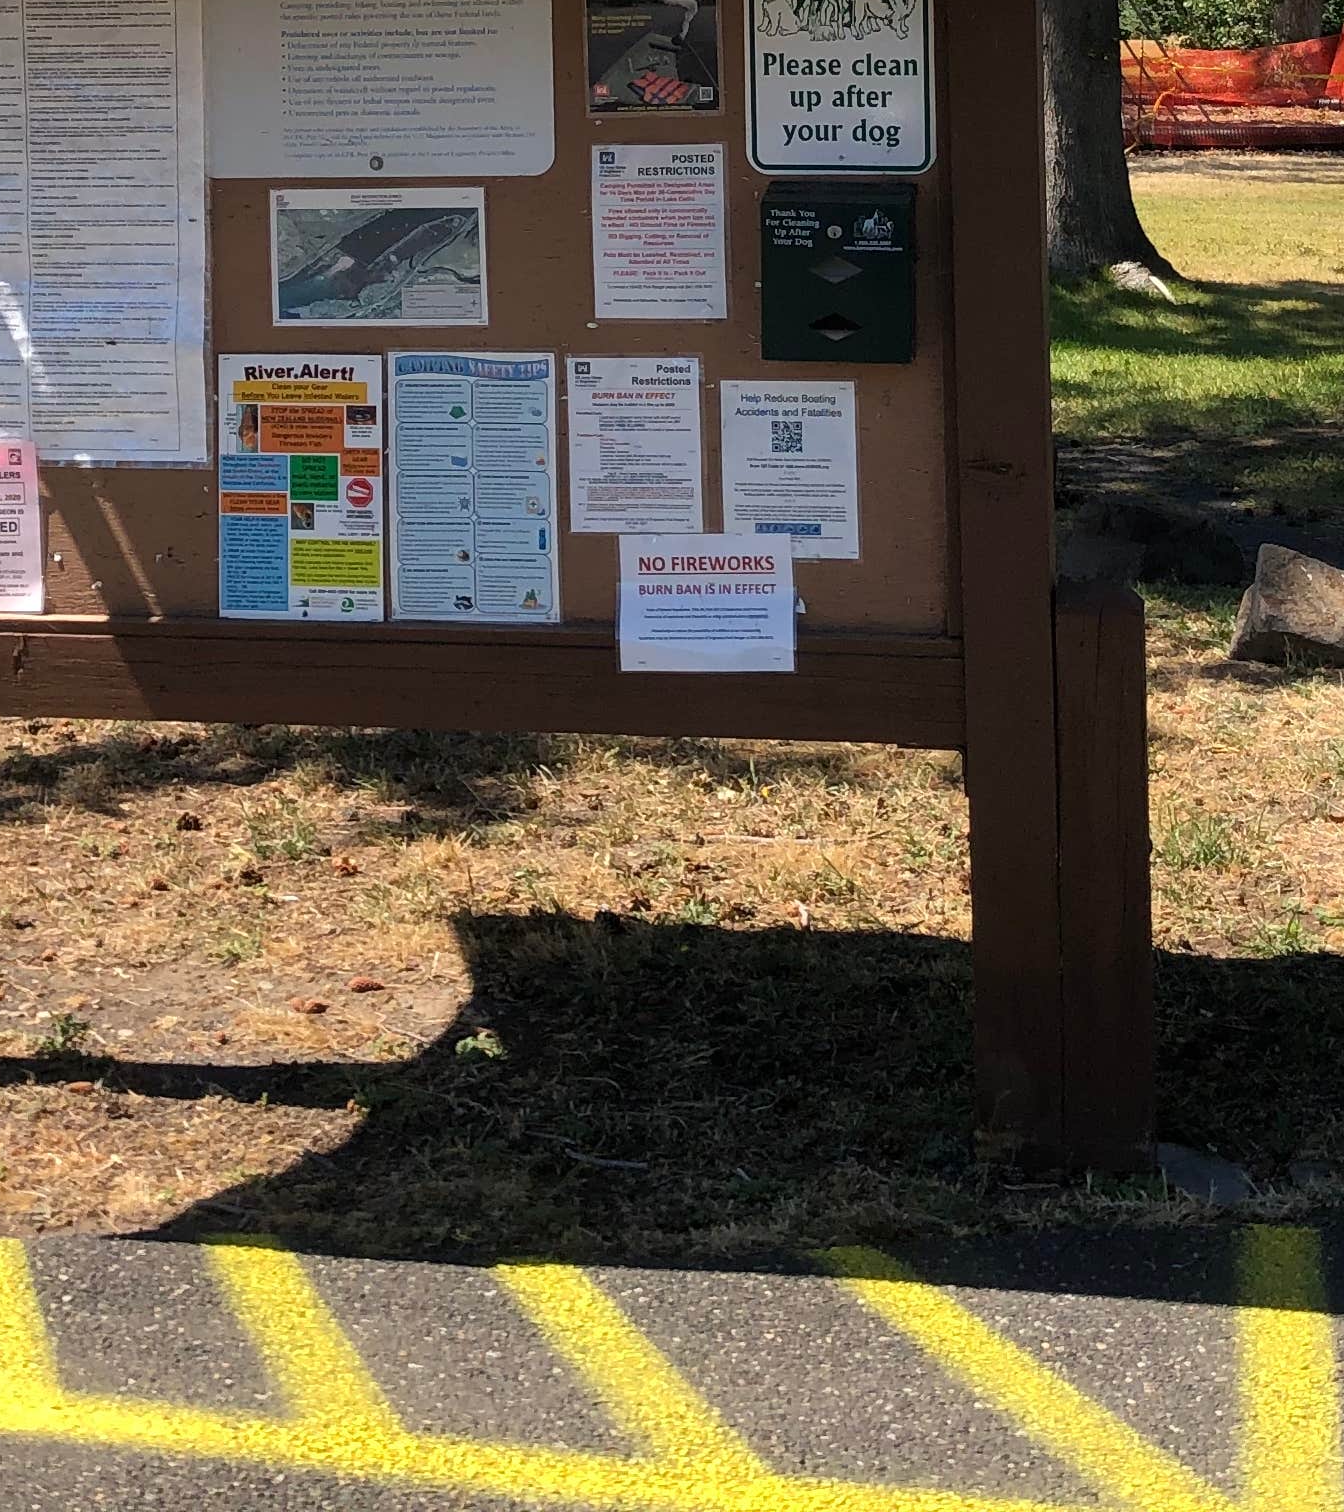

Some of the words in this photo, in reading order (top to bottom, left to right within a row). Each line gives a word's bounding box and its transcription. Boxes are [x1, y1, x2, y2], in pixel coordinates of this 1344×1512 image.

[763, 52, 841, 77] Please
[851, 52, 919, 76] clean
[790, 87, 822, 112] up
[831, 85, 893, 108] after
[782, 123, 843, 146] your
[851, 119, 901, 147] dog
[672, 154, 714, 164] POSTED
[638, 167, 715, 176] RESTRICTIONS
[770, 209, 796, 217] Thank
[799, 209, 815, 218] You
[766, 219, 781, 227] For
[783, 219, 820, 229] Cleaning
[775, 229, 787, 237] Up
[773, 238, 793, 246] Your
[795, 238, 813, 247] Dog
[244, 365, 294, 381] River
[299, 364, 354, 381] Alert!
[656, 364, 691, 374] Posted
[632, 377, 691, 386] Restrictions
[741, 394, 761, 404] Help
[764, 394, 798, 403] Reduce
[802, 394, 836, 405] Boating
[736, 408, 779, 416] Accidents
[782, 408, 798, 416] and
[802, 408, 842, 417] Fatalities
[638, 557, 665, 571] NO
[672, 556, 774, 571] FIREWORKS
[639, 585, 672, 595] BURN
[676, 585, 701, 594] BAN
[705, 585, 715, 594] IS
[719, 584, 731, 594] IN
[735, 584, 776, 594] EFFECT
